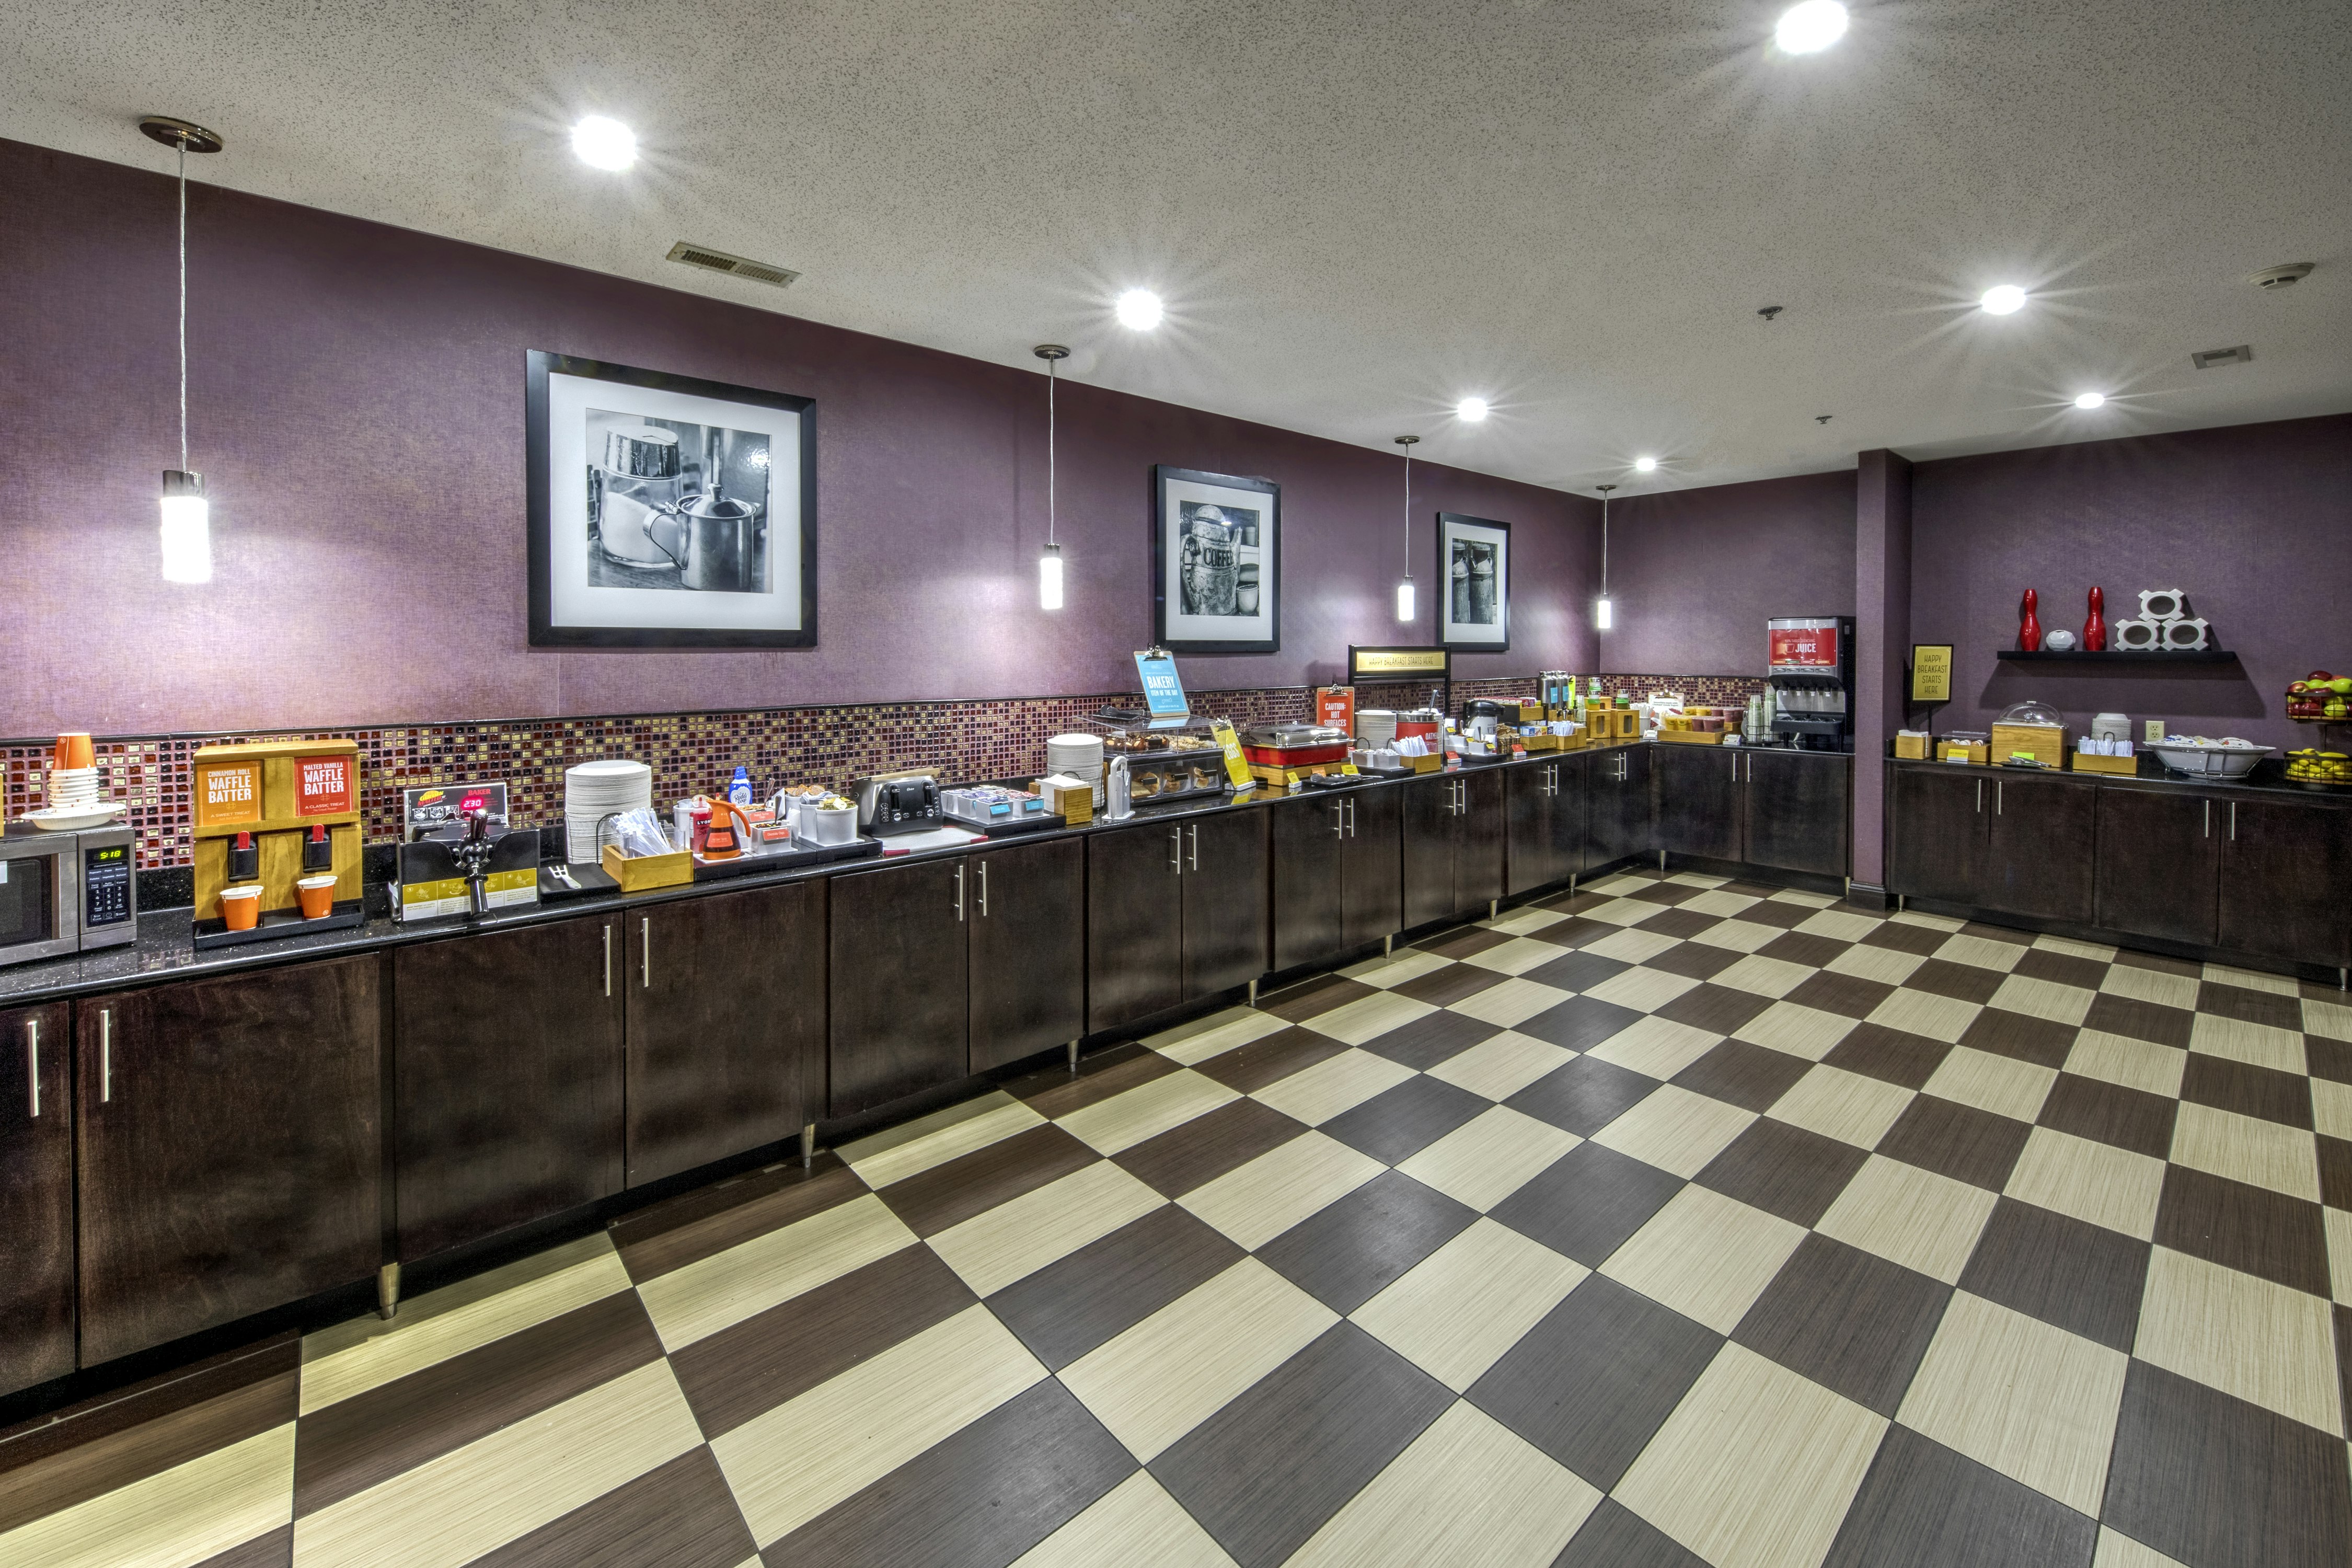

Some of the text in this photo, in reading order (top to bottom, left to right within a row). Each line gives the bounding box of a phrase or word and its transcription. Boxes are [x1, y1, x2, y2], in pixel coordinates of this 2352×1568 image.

[1204, 548, 1233, 567] COFFEE
[1795, 643, 1816, 653] JUICE
[1369, 656, 1433, 665] HAPPY BREAKFAST STARTS HERE
[1924, 654, 1942, 663] HAPPY
[1917, 665, 1947, 673] BREAKFAST
[1147, 676, 1175, 688] BAKERY
[1922, 675, 1941, 684] STARTS
[1924, 686, 1938, 694] HERE
[1225, 743, 1240, 760] EGGS
[304, 768, 344, 783] WAFFLE
[208, 775, 251, 790] WAFFLE
[304, 780, 344, 795] BATTER
[209, 788, 251, 803] BATTER
[100, 850, 121, 859] 5:18
